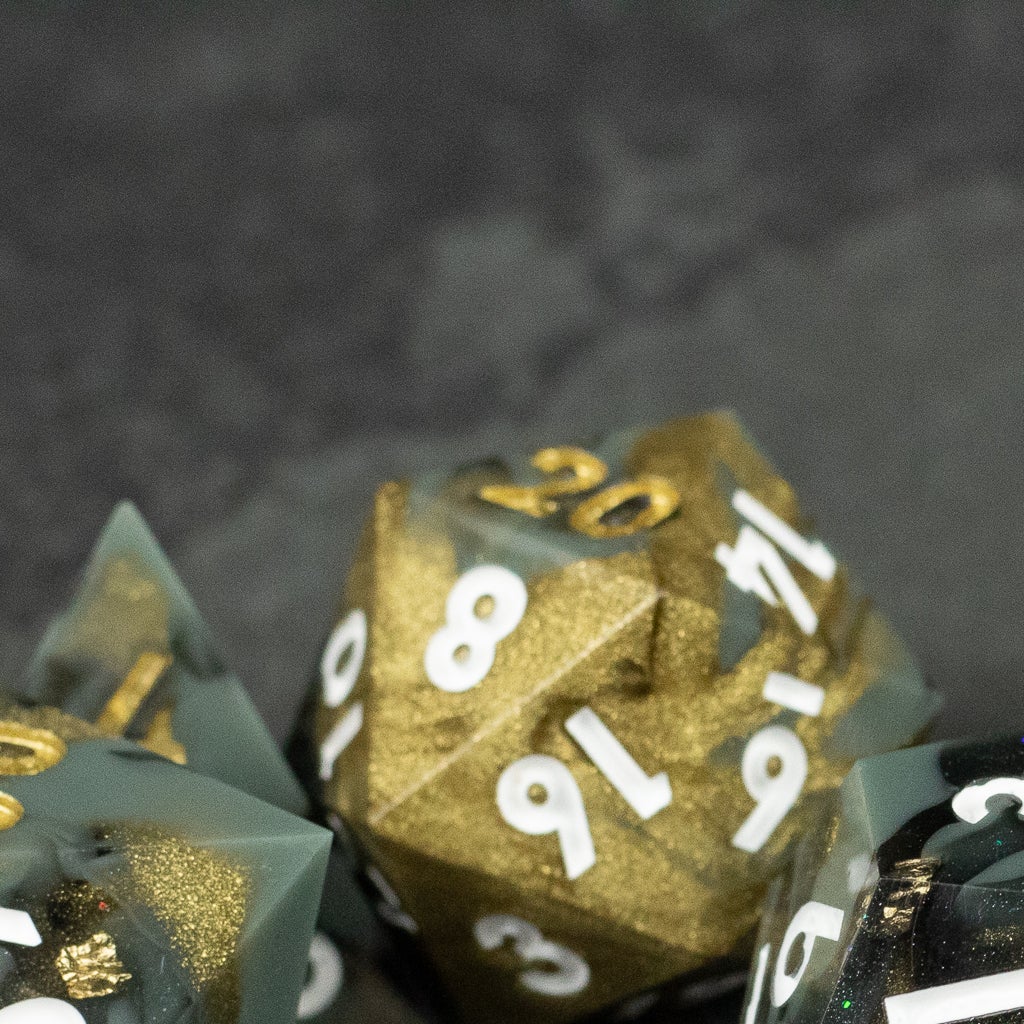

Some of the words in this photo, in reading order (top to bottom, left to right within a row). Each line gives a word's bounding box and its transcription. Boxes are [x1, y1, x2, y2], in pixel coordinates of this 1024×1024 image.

[481, 446, 681, 539] 20
[425, 564, 528, 692] 8
[714, 488, 838, 635] 14
[319, 609, 368, 782] 10
[496, 706, 672, 880] 16
[473, 913, 591, 997] 3
